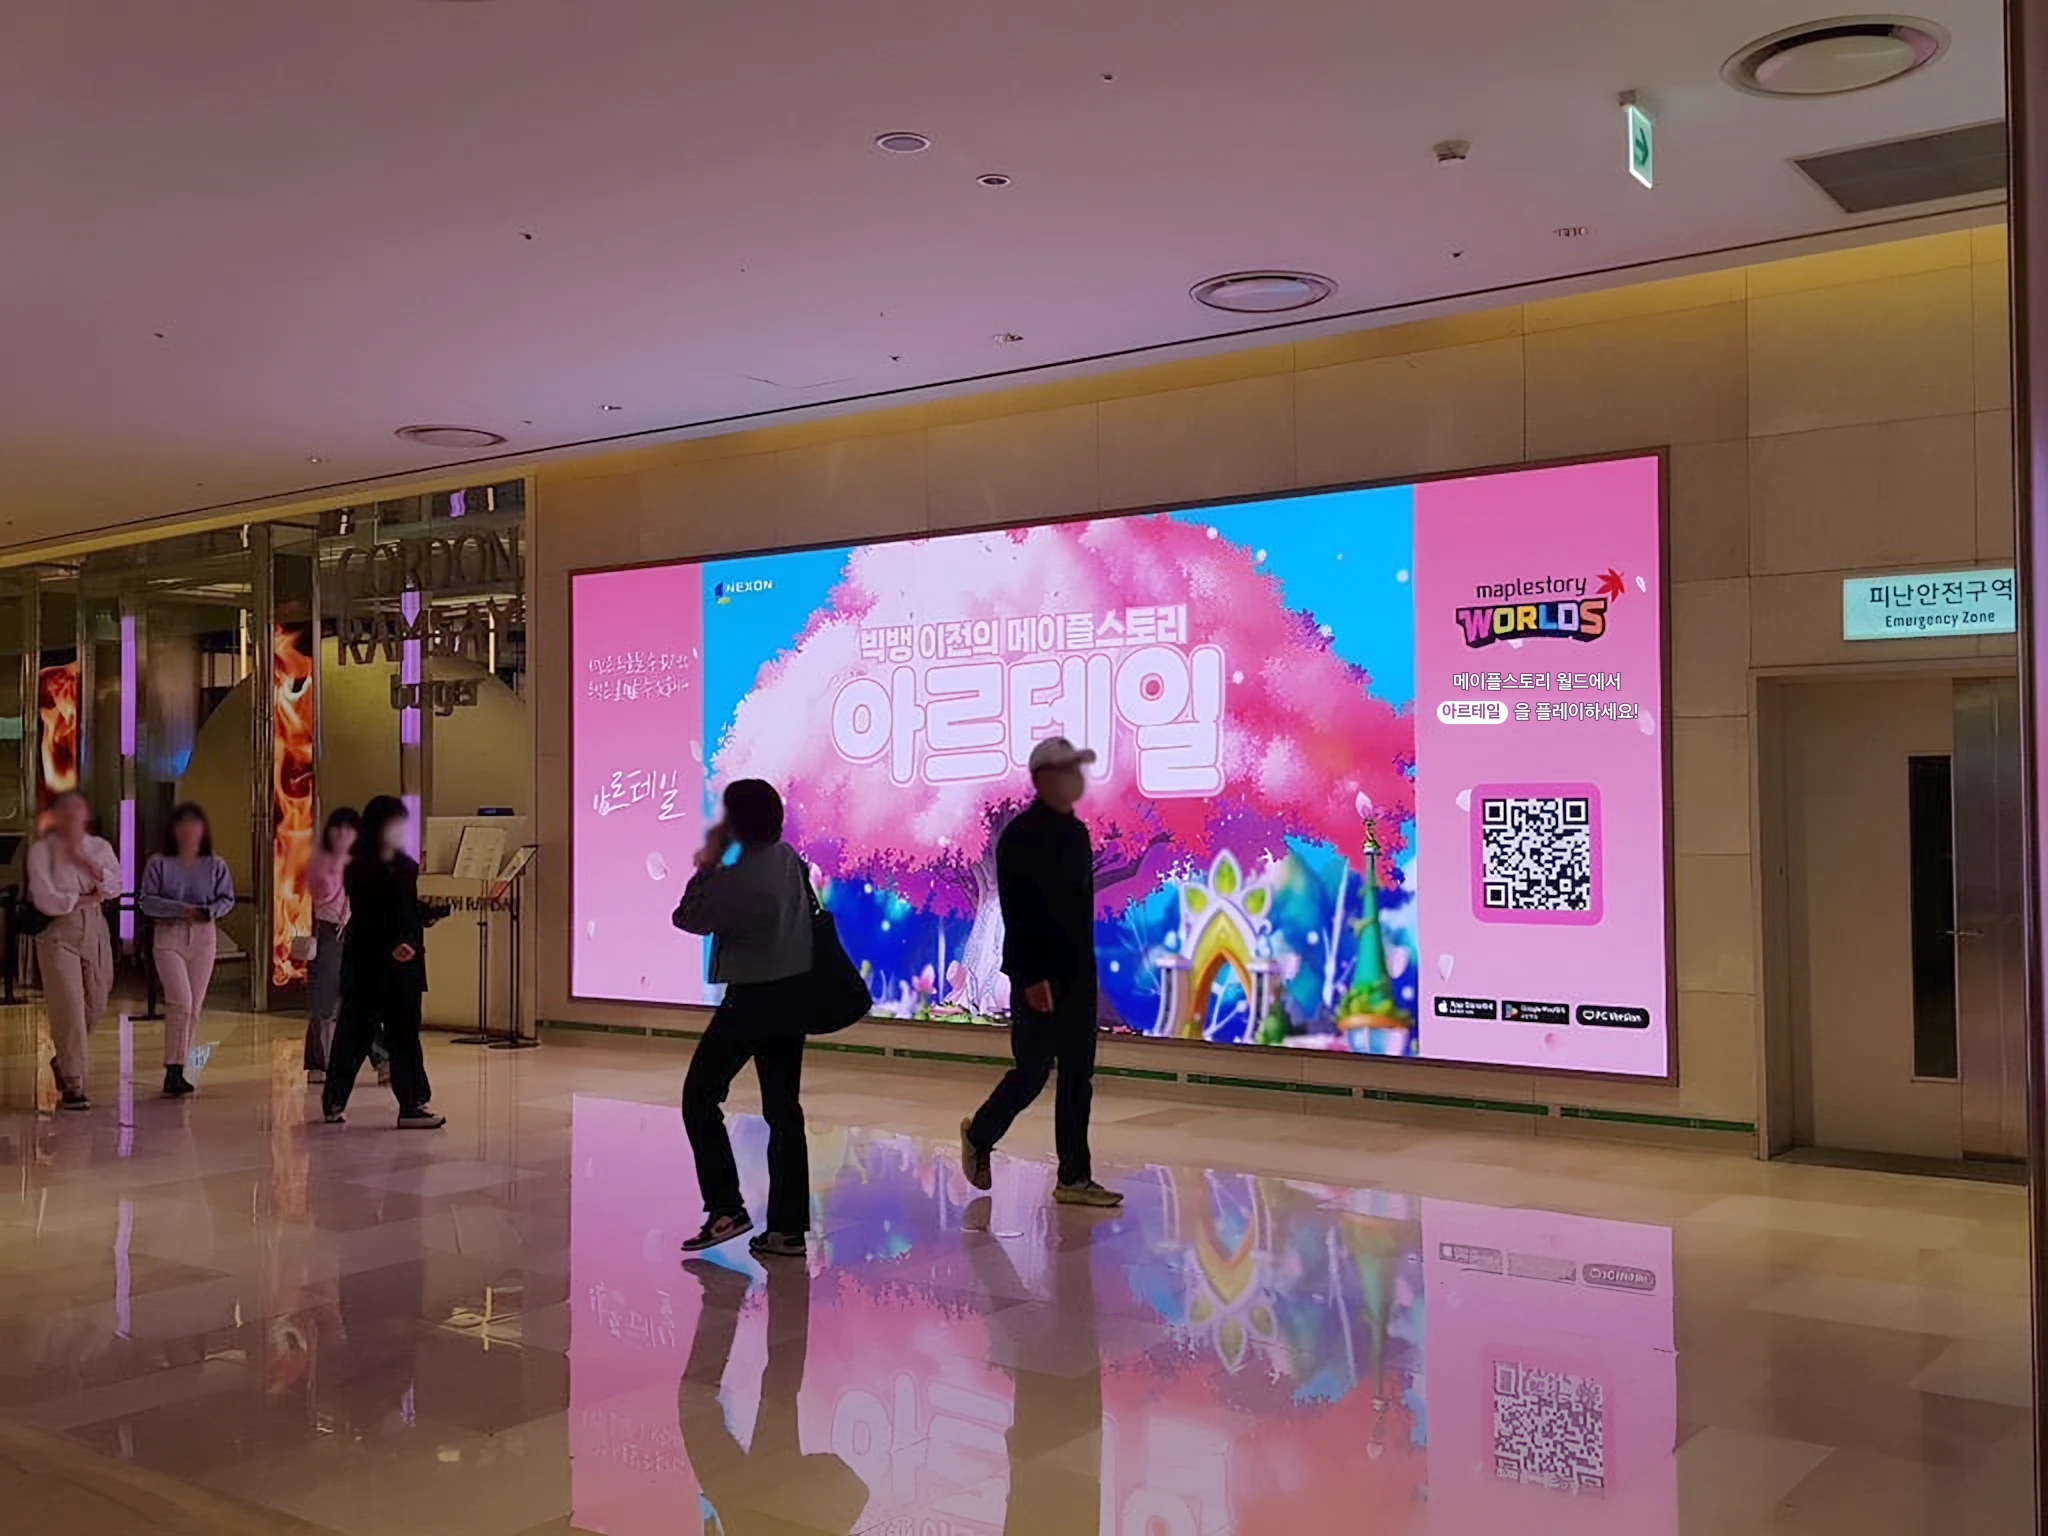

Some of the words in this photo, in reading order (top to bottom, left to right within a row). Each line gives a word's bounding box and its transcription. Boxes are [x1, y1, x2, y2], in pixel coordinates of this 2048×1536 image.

[725, 579, 773, 593] NEXON
[1476, 575, 1587, 601] maplestory
[1869, 577, 2013, 608] 피난안전구역
[859, 625, 914, 662] 빅뱅
[919, 618, 999, 659] 이전의
[1007, 603, 1188, 653] 메이플스토리
[1456, 598, 1608, 648] WORLDS
[1885, 613, 1959, 629] Emergency
[1962, 611, 1996, 624] Zone
[1452, 672, 1551, 692] 메이플스토리
[1556, 672, 1622, 692] 월드에서
[831, 643, 1226, 799] 아르테일
[1442, 702, 1501, 720] 아르테일
[1514, 702, 1531, 721] 을
[1535, 702, 1639, 722] 플레이하세요!
